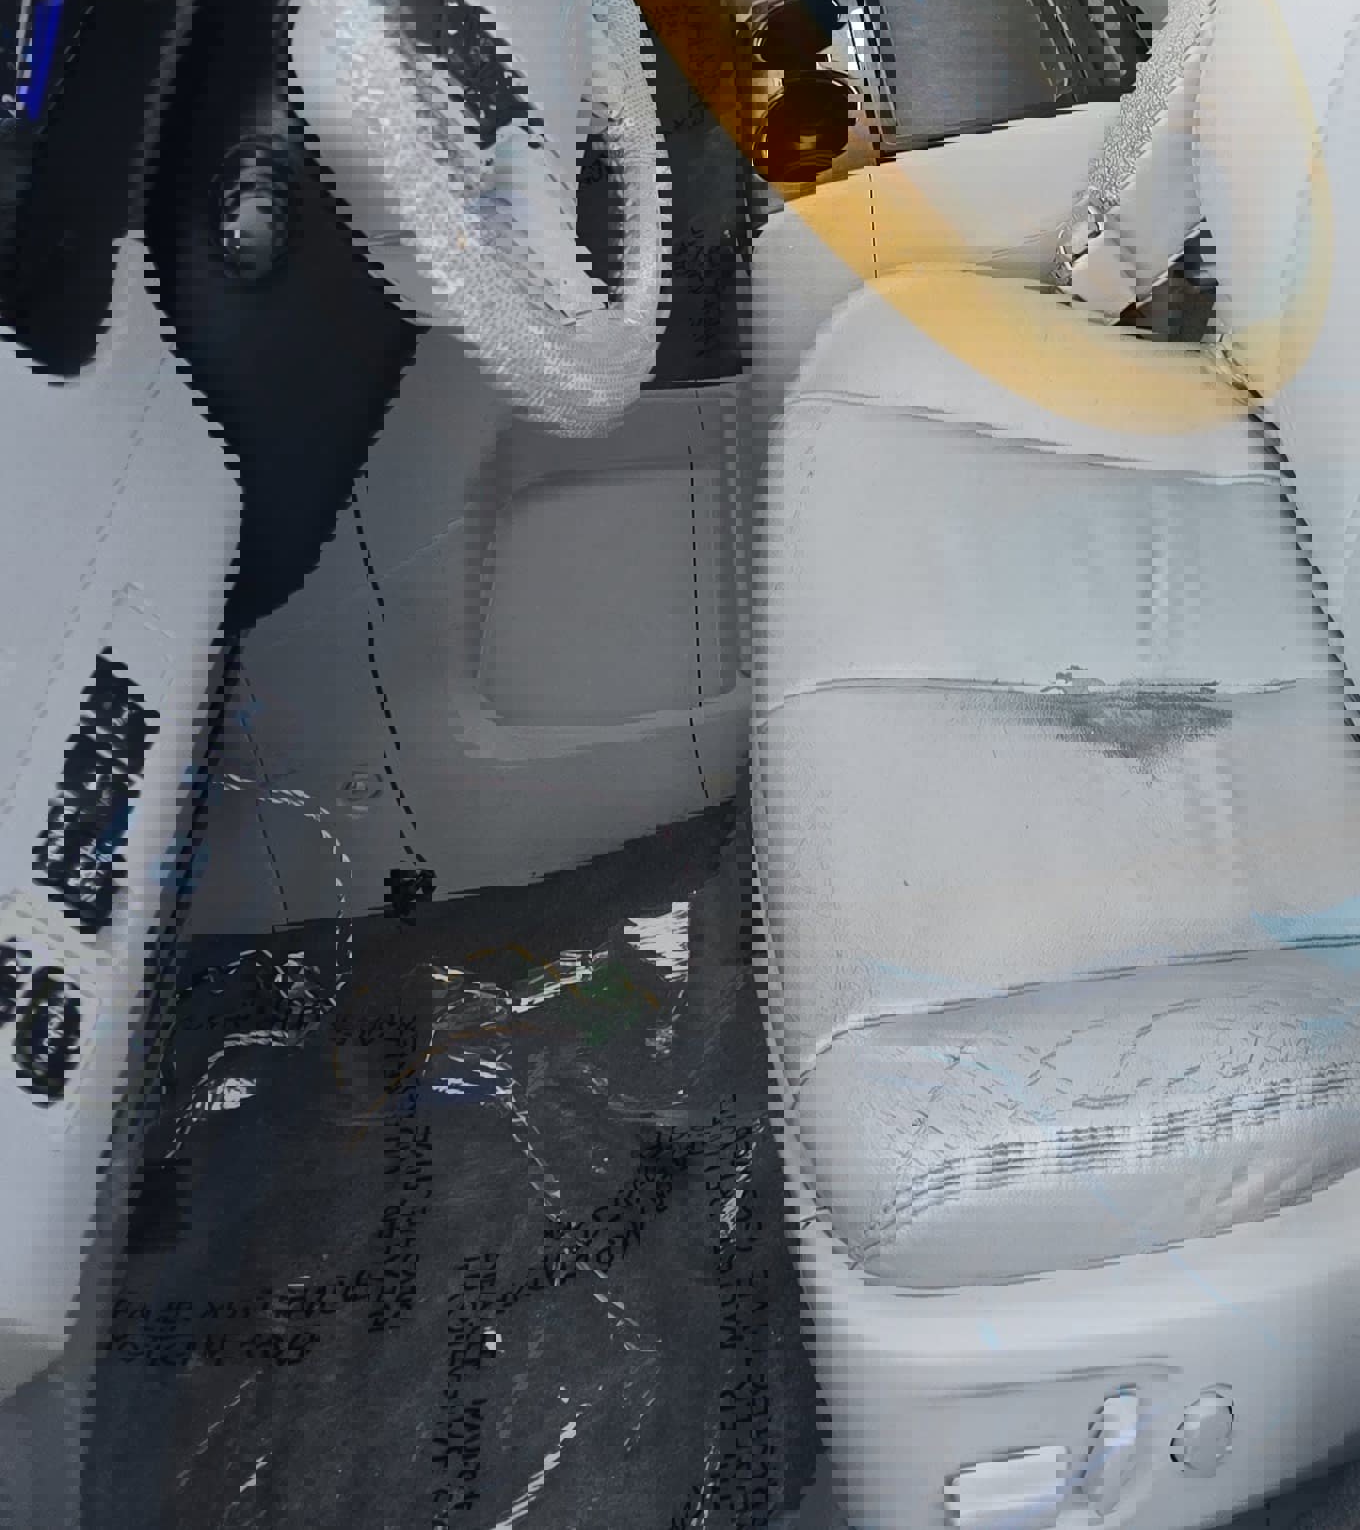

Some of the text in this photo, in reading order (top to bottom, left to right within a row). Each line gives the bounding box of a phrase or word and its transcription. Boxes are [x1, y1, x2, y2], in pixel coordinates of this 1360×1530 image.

[207, 780, 225, 807] OFF
[94, 803, 142, 861] REAR VENT
[166, 831, 193, 861] PULL
[189, 841, 214, 874] PUSH
[19, 950, 42, 971] R
[84, 994, 131, 1063] MIRROR
[790, 1118, 862, 1323] PROTECTIVE
[1185, 1206, 1286, 1271] MUST
[226, 1263, 744, 1325] EALER MUST REMOVE
[741, 1199, 799, 1328] DEALER
[1000, 1239, 1168, 1308] REMOVE
[216, 1324, 635, 1366] ROTECTIVE COVER
[877, 1254, 949, 1468] PROTECTIVE
[920, 1244, 996, 1504] DEALER MUST
